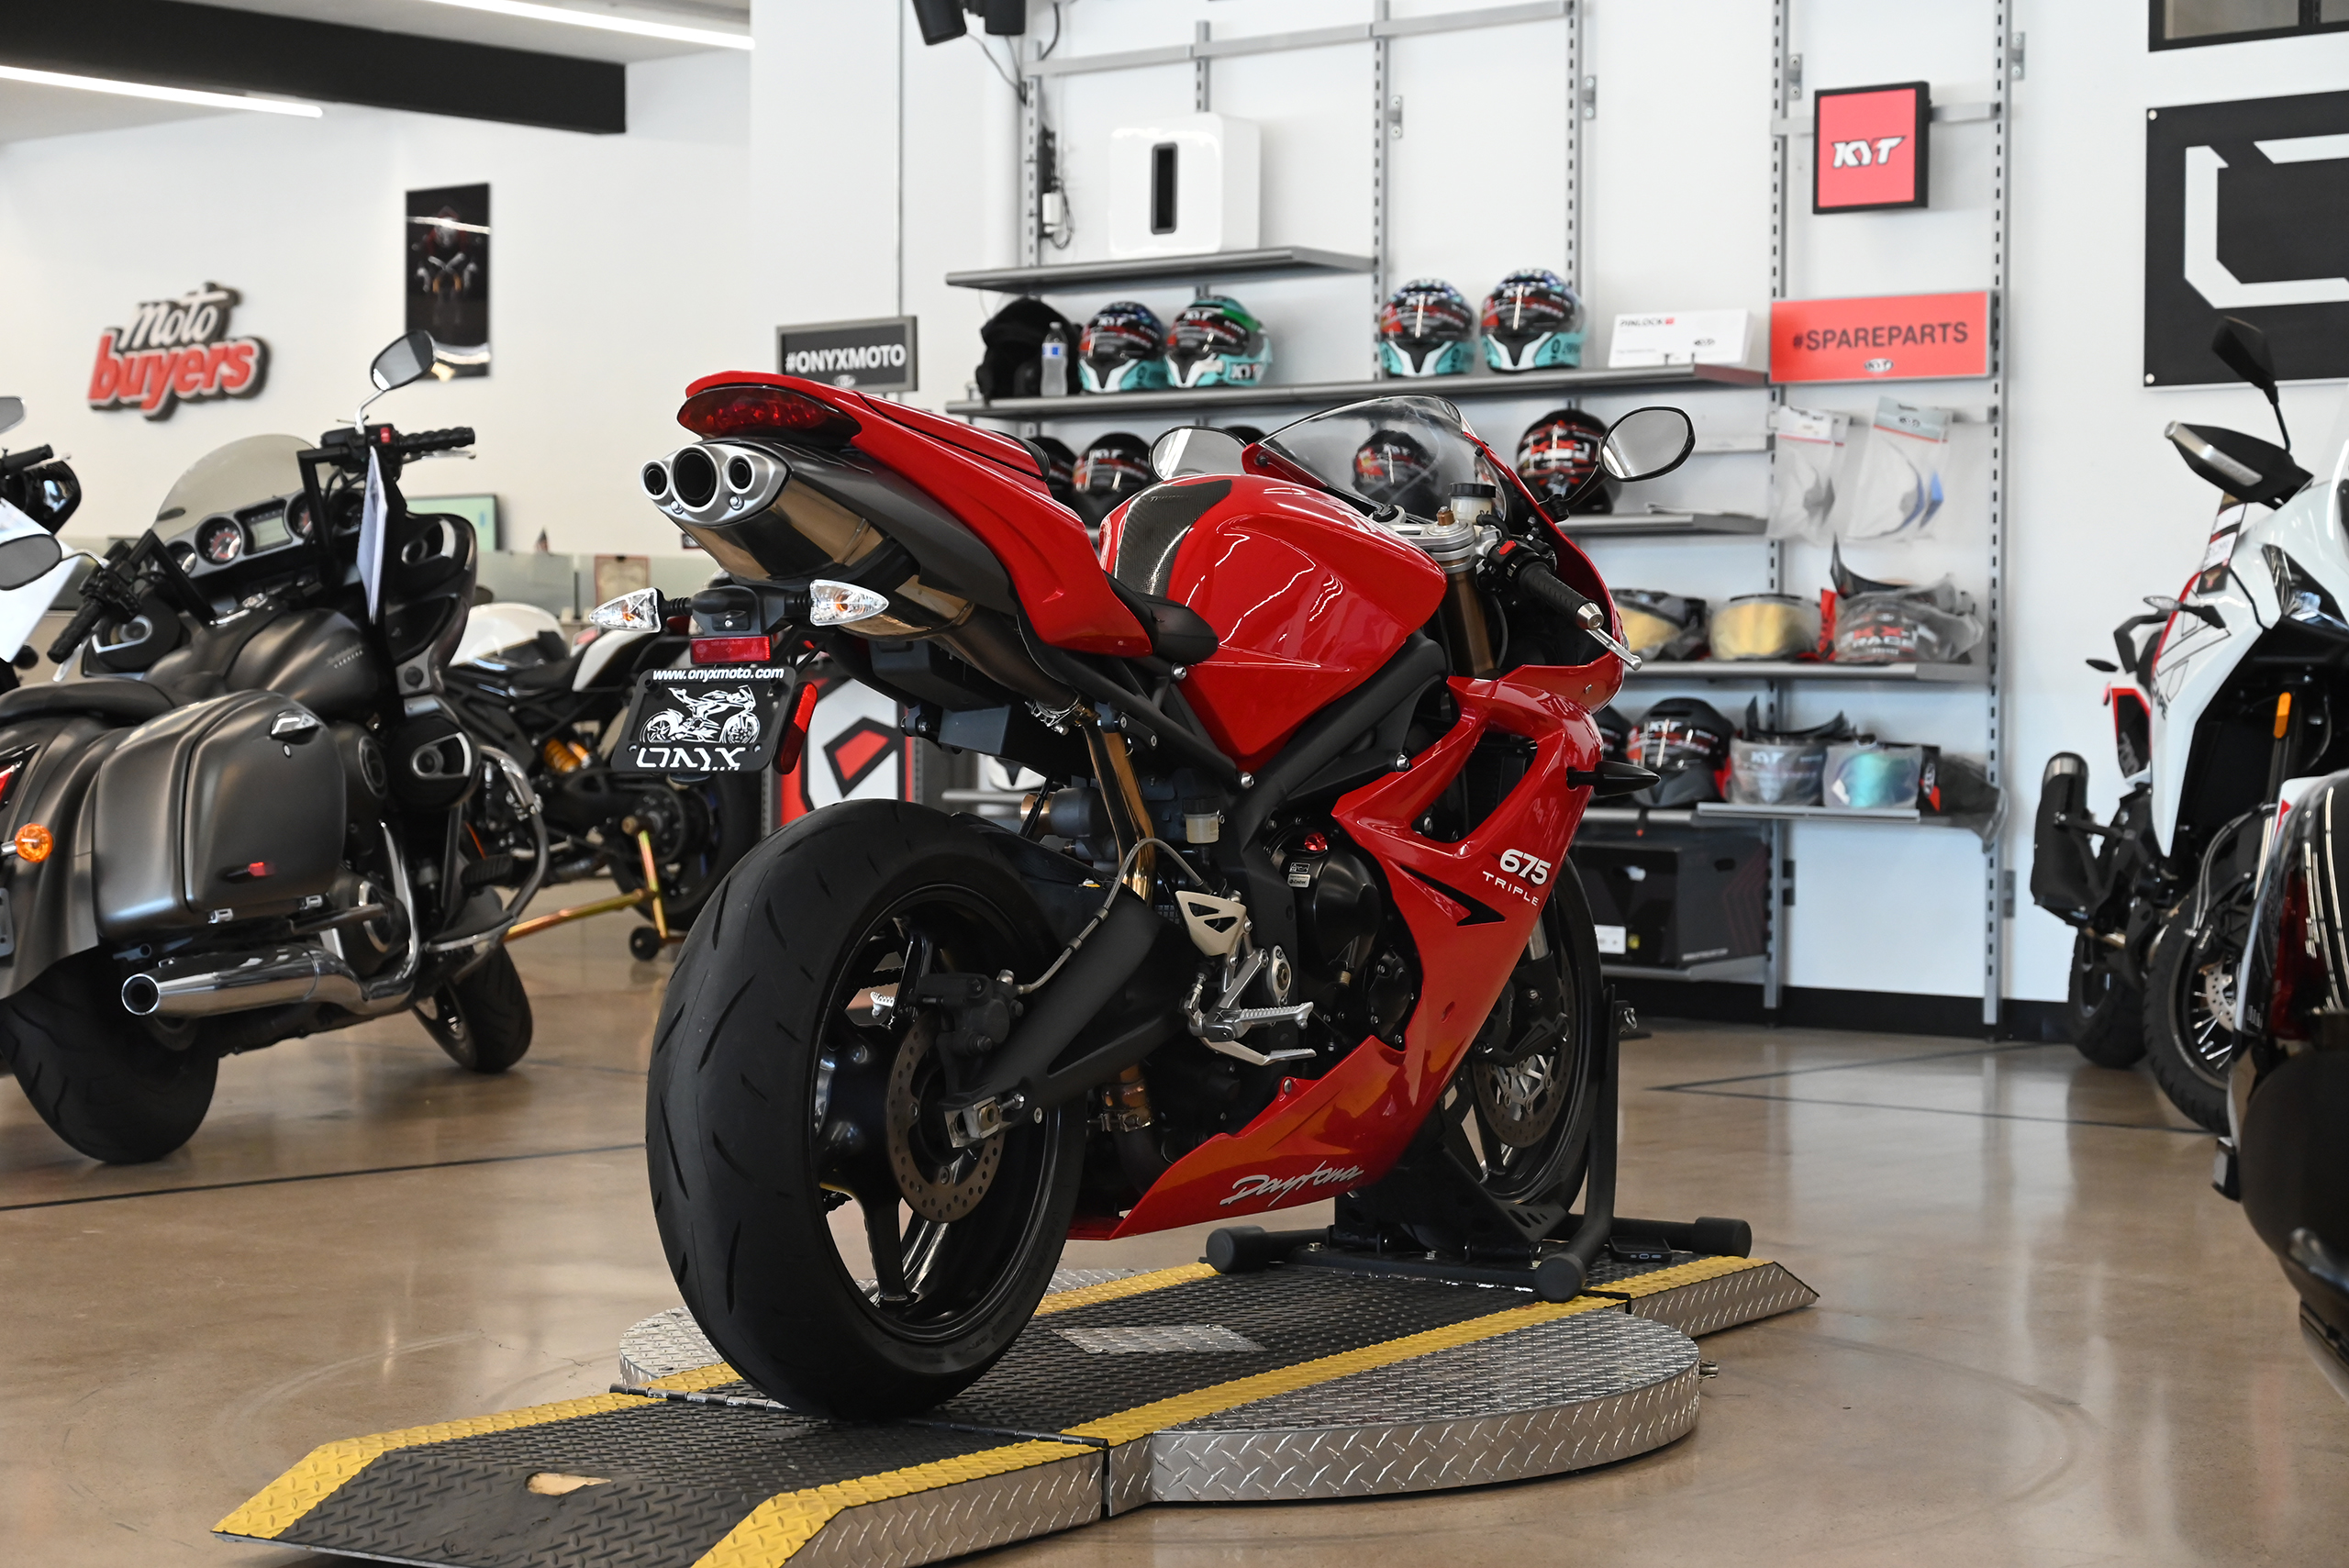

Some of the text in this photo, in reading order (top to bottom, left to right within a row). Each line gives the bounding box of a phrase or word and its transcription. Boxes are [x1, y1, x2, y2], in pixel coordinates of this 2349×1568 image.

[1831, 135, 1906, 170] KYT
[1793, 321, 1969, 352] #SPAREPARTS
[89, 333, 255, 413] buyers
[785, 343, 907, 374] #ONYXMOTO
[652, 667, 785, 683] www.onyxmoto.com
[1499, 848, 1553, 885] 675
[1482, 871, 1540, 906] TRIPLE
[1219, 1160, 1364, 1207] Daytona
